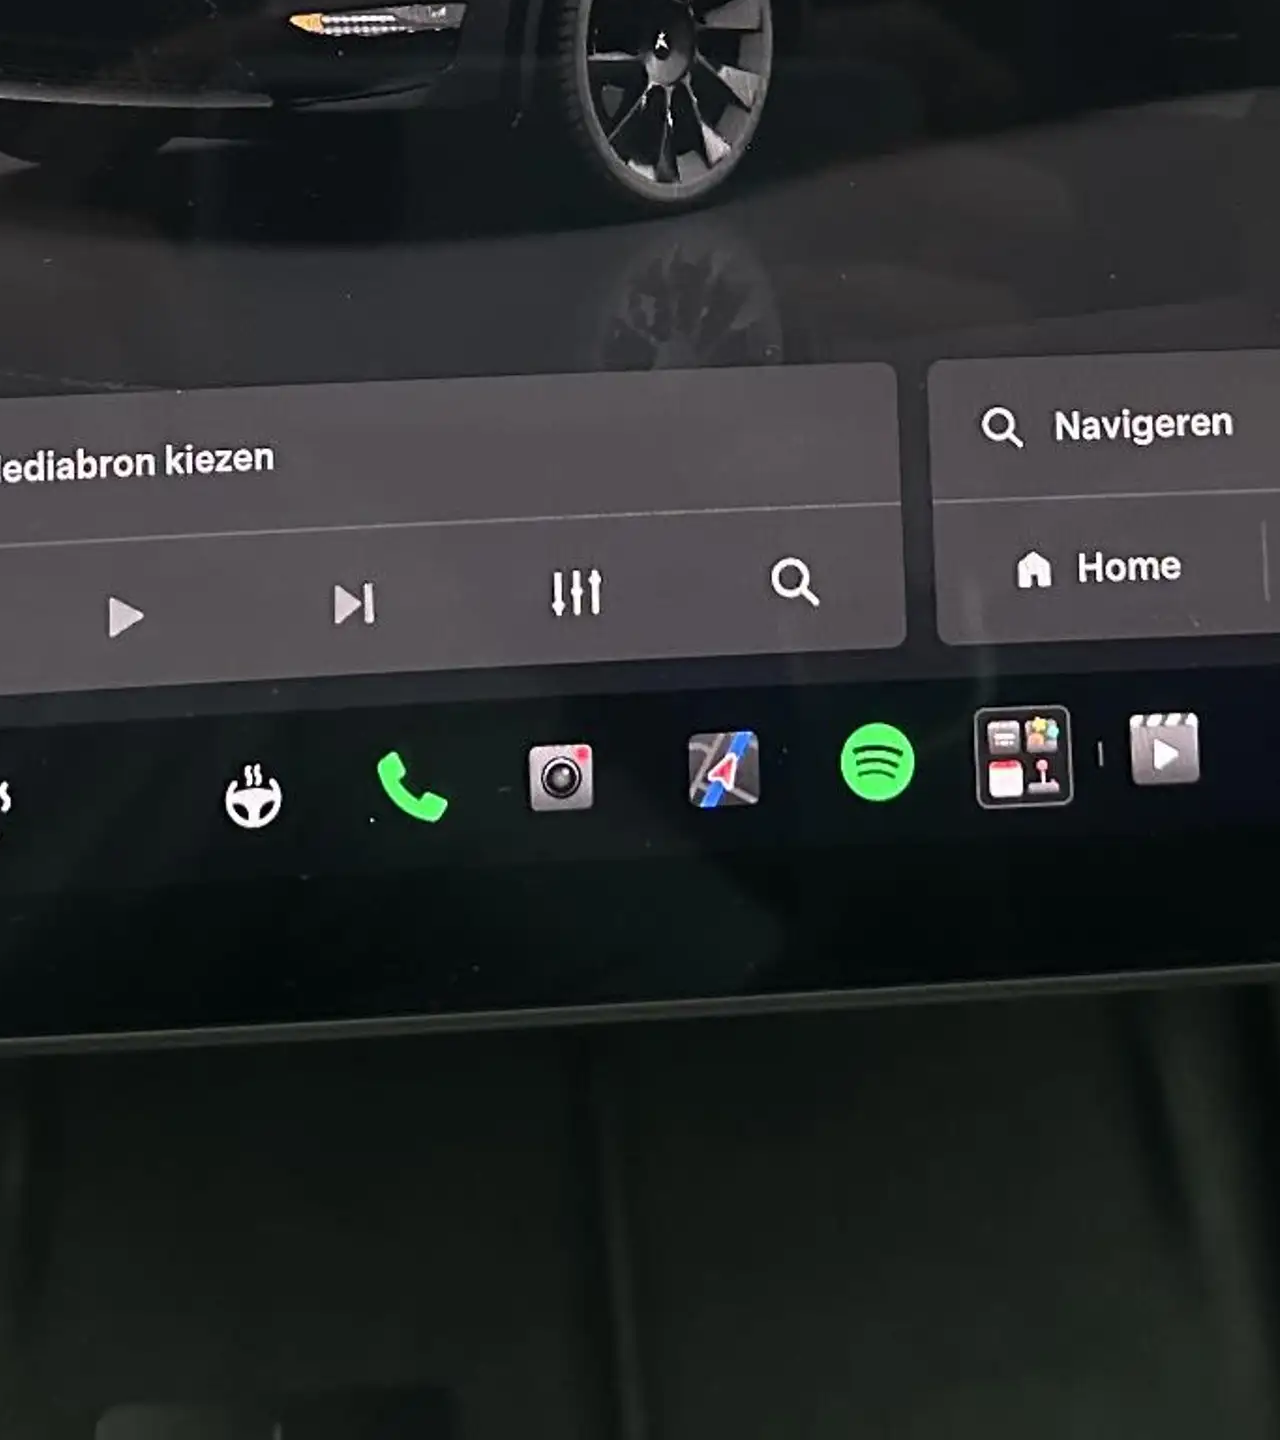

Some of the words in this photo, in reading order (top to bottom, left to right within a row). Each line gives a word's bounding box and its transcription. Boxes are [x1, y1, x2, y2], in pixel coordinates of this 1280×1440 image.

[1054, 408, 1235, 446] Navigeren
[164, 442, 275, 476] kiezen
[1077, 551, 1183, 583] Home
